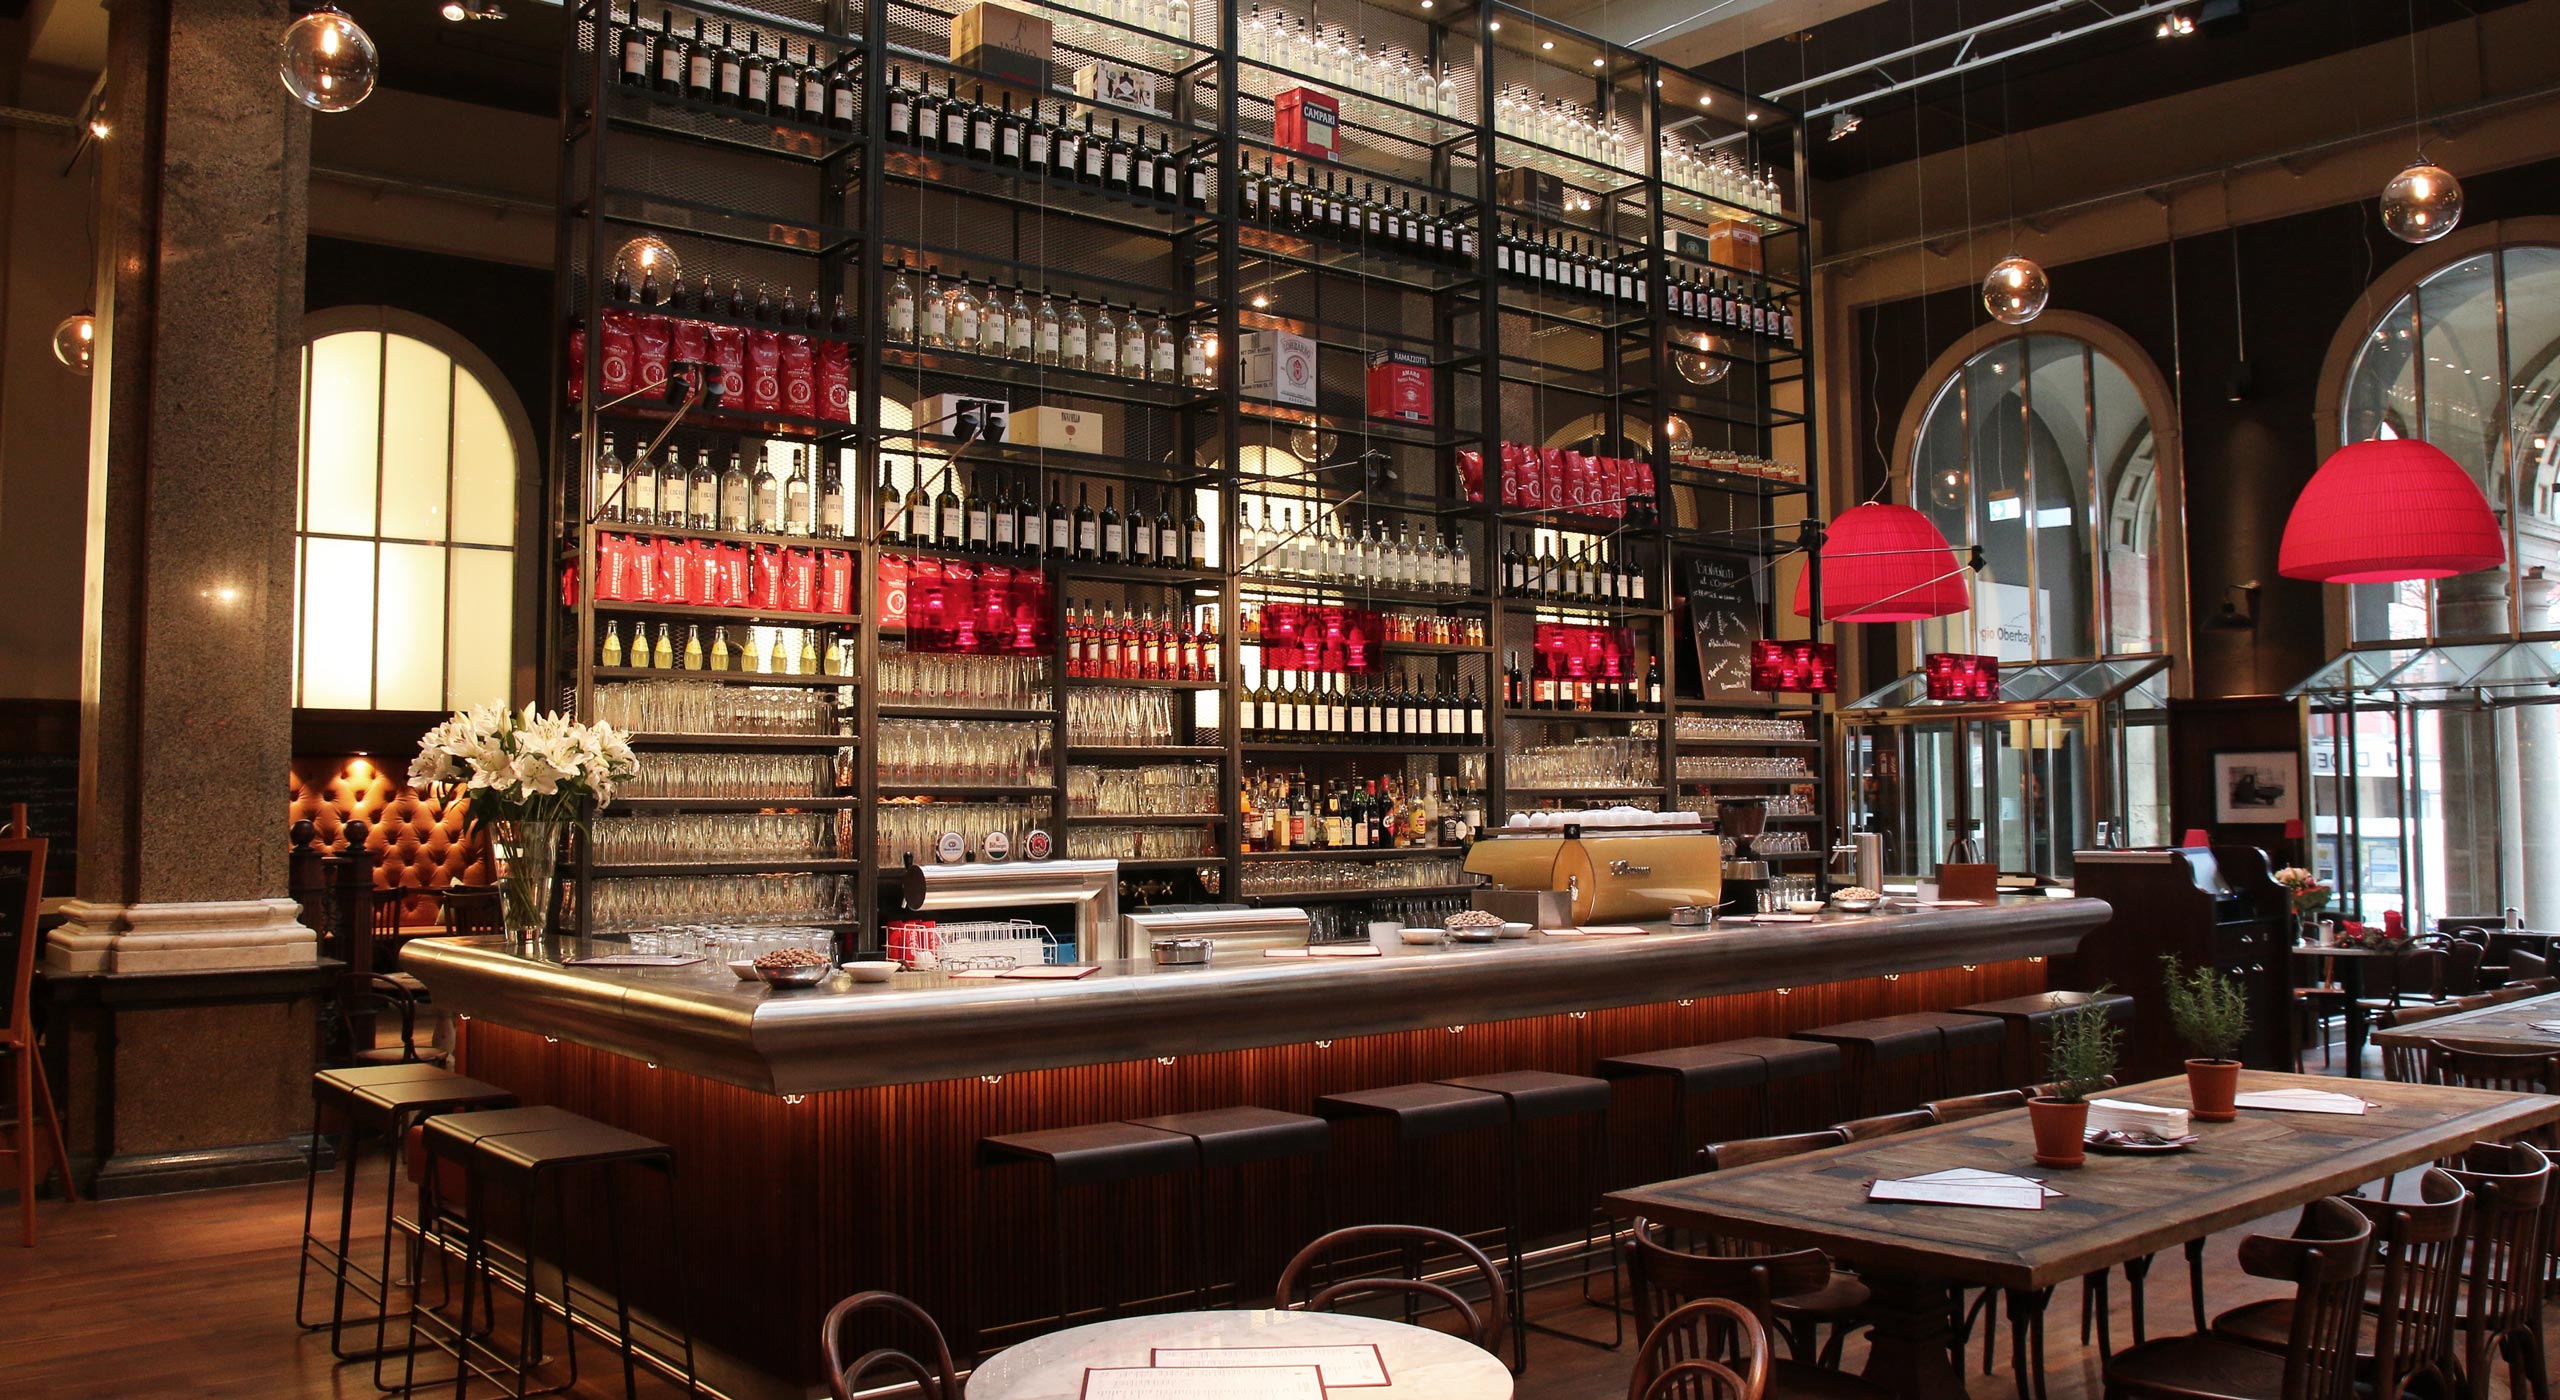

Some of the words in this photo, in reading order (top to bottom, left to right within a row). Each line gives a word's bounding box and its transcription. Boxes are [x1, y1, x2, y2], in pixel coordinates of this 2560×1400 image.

[1303, 105, 1336, 125] CAMPARI
[1394, 352, 1427, 365] RAMAZZOTTI
[1402, 370, 1420, 379] AMARO
[1997, 628, 2046, 645] Oberbayn
